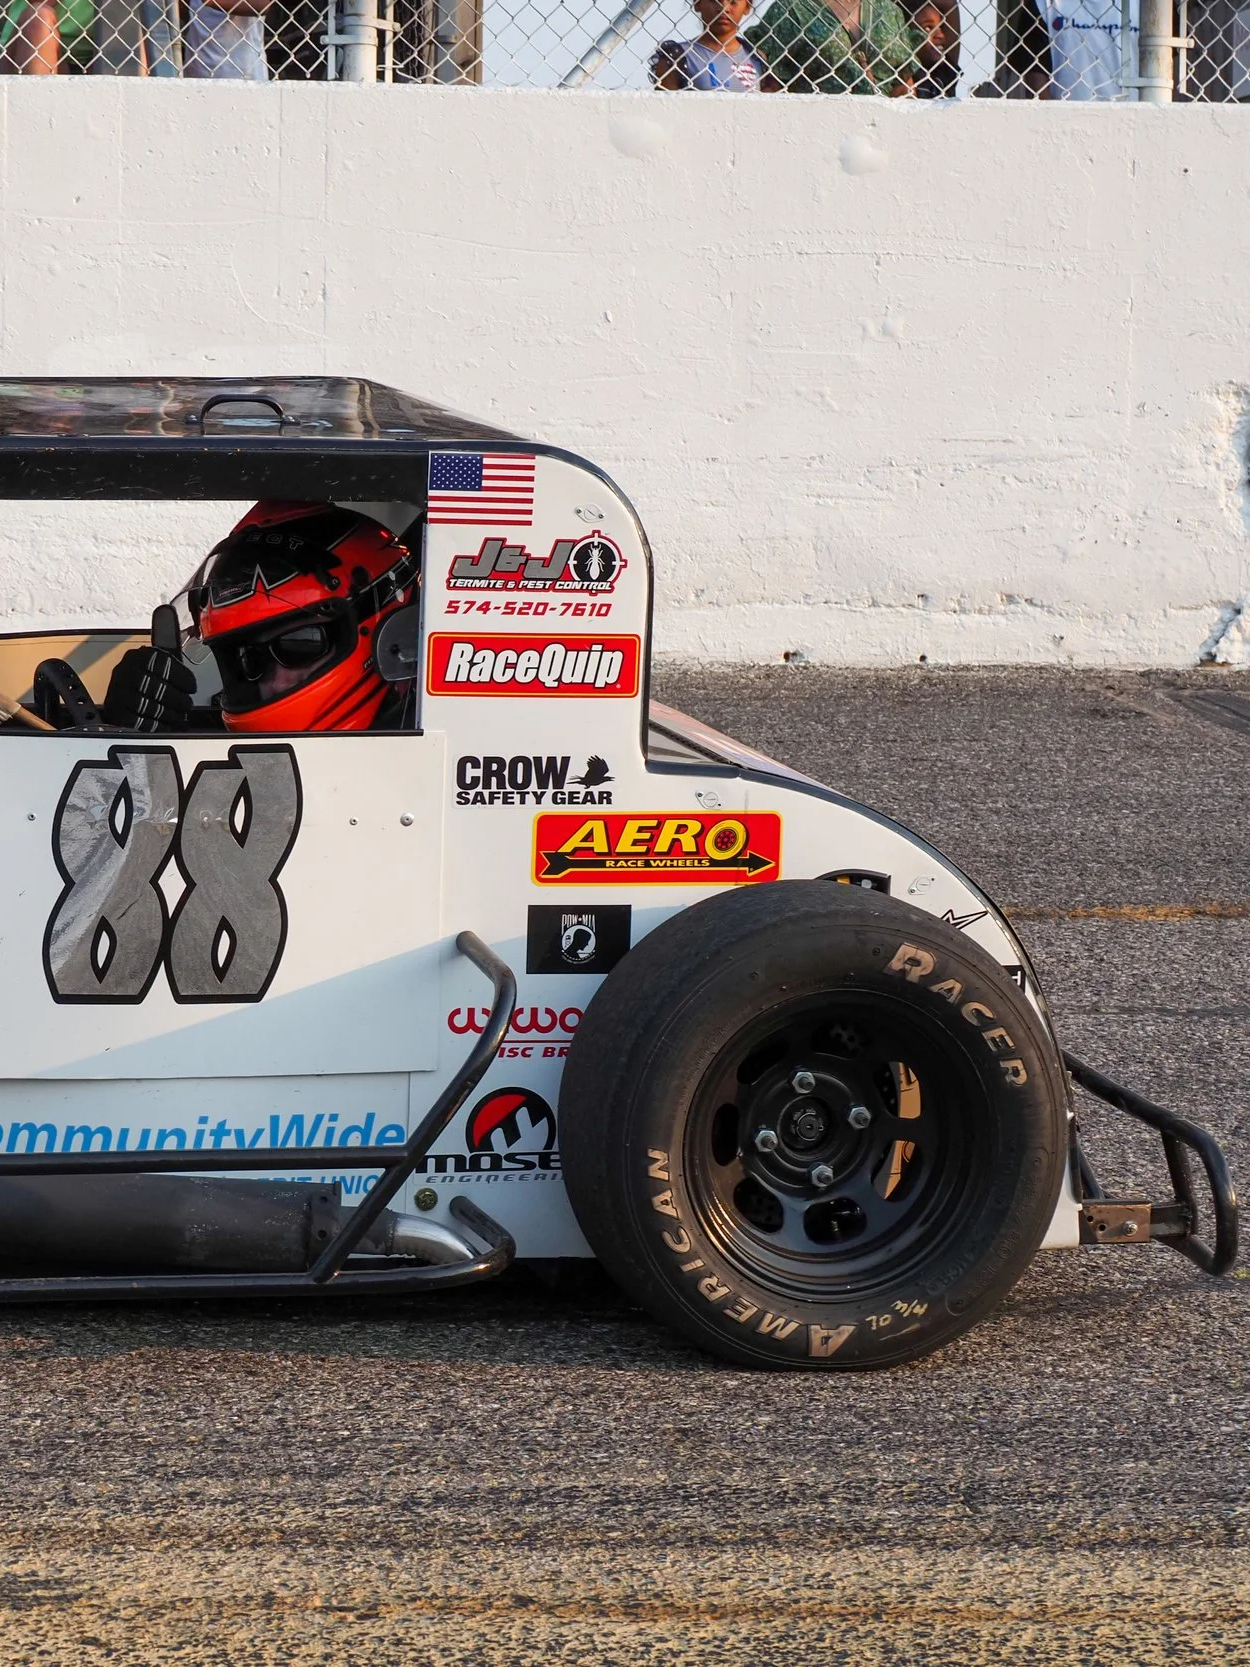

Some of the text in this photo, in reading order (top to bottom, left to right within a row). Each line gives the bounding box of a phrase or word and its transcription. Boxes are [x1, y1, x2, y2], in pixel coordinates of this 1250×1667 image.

[450, 538, 576, 580] J&J
[449, 578, 612, 591] TERMITE & PEST CONTROL
[444, 600, 612, 617] 574-520-7610
[445, 642, 624, 688] RaceQuip
[456, 755, 572, 791] CROW
[455, 790, 613, 806] SAFETY GEAR
[556, 818, 749, 860] AERO
[42, 743, 303, 1005] 88
[605, 858, 711, 868] RACE WHEELS
[883, 941, 1028, 1088] RACER
[646, 1148, 857, 1359] AMERICAN
